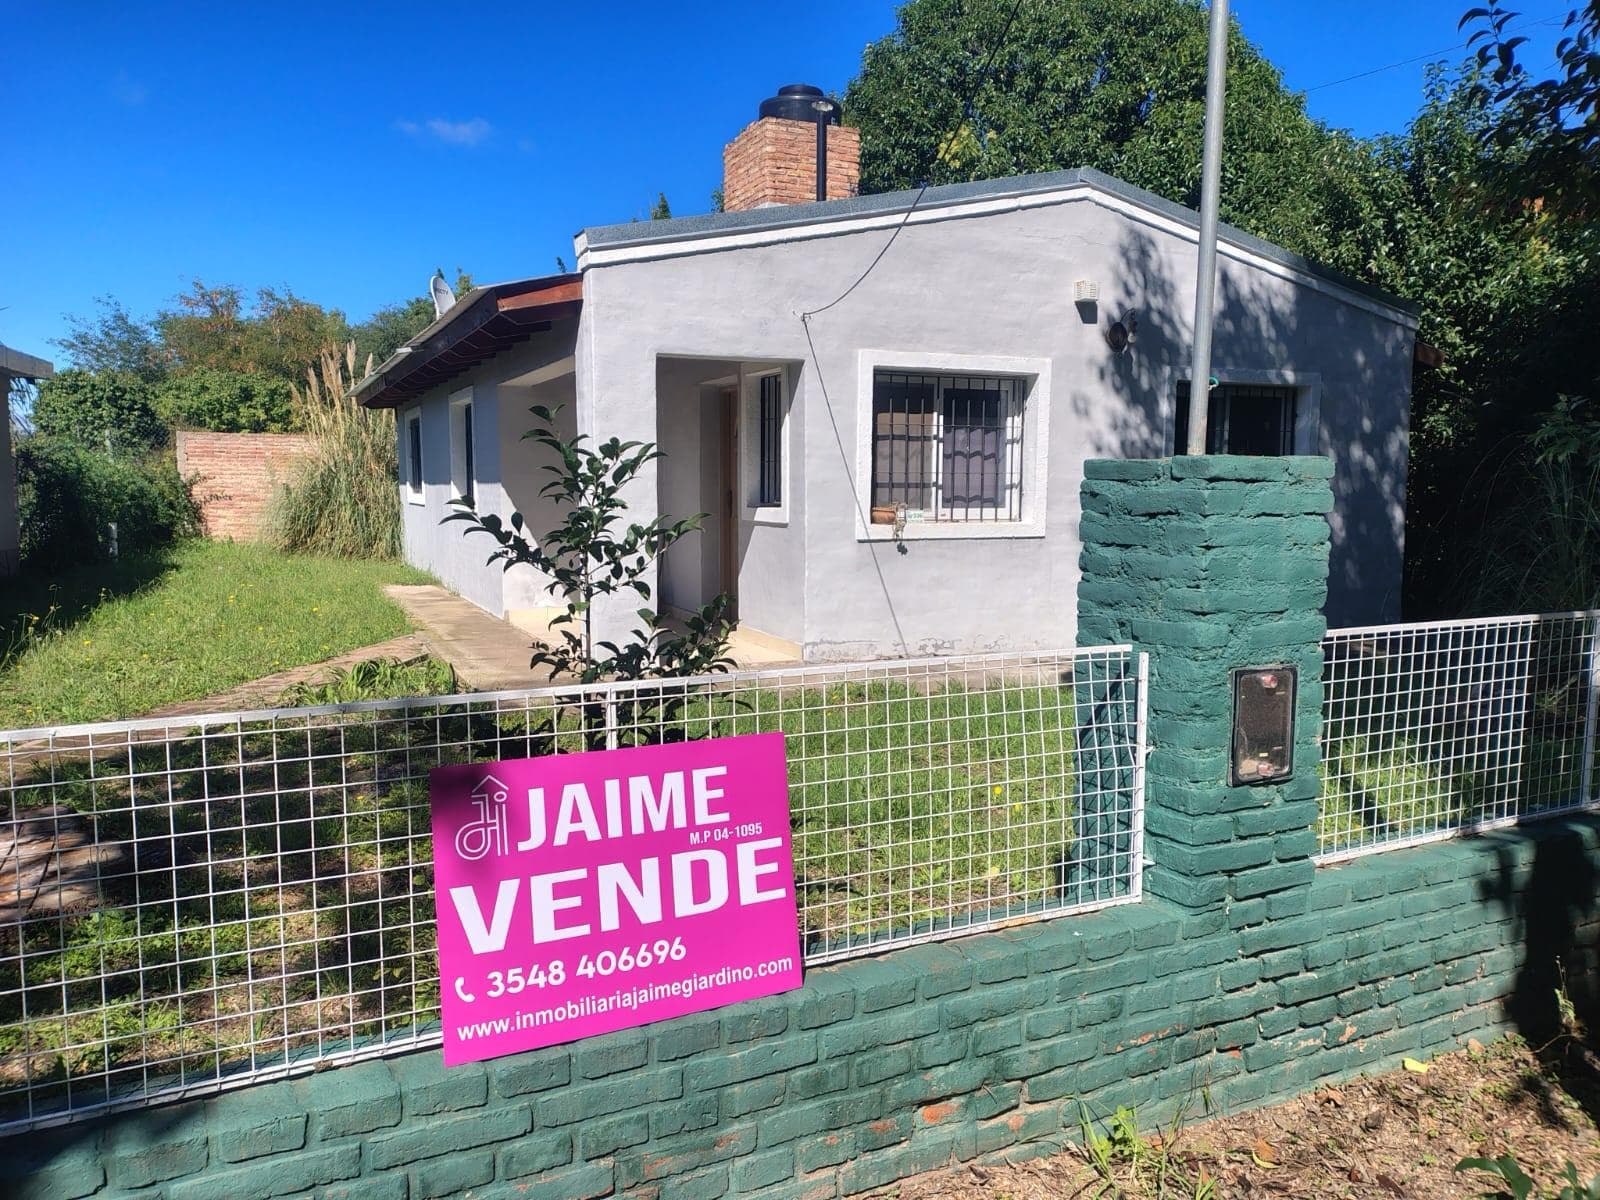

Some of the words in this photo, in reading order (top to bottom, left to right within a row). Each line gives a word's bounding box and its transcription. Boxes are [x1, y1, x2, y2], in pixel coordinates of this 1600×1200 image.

[517, 766, 731, 852] JAIME
[714, 822, 763, 842] 04-1095
[449, 837, 787, 956] VENDE
[457, 955, 794, 1041] www.inmobiliariajaimegiardino.com
[487, 959, 566, 998] 3548
[576, 936, 687, 979] 406696
